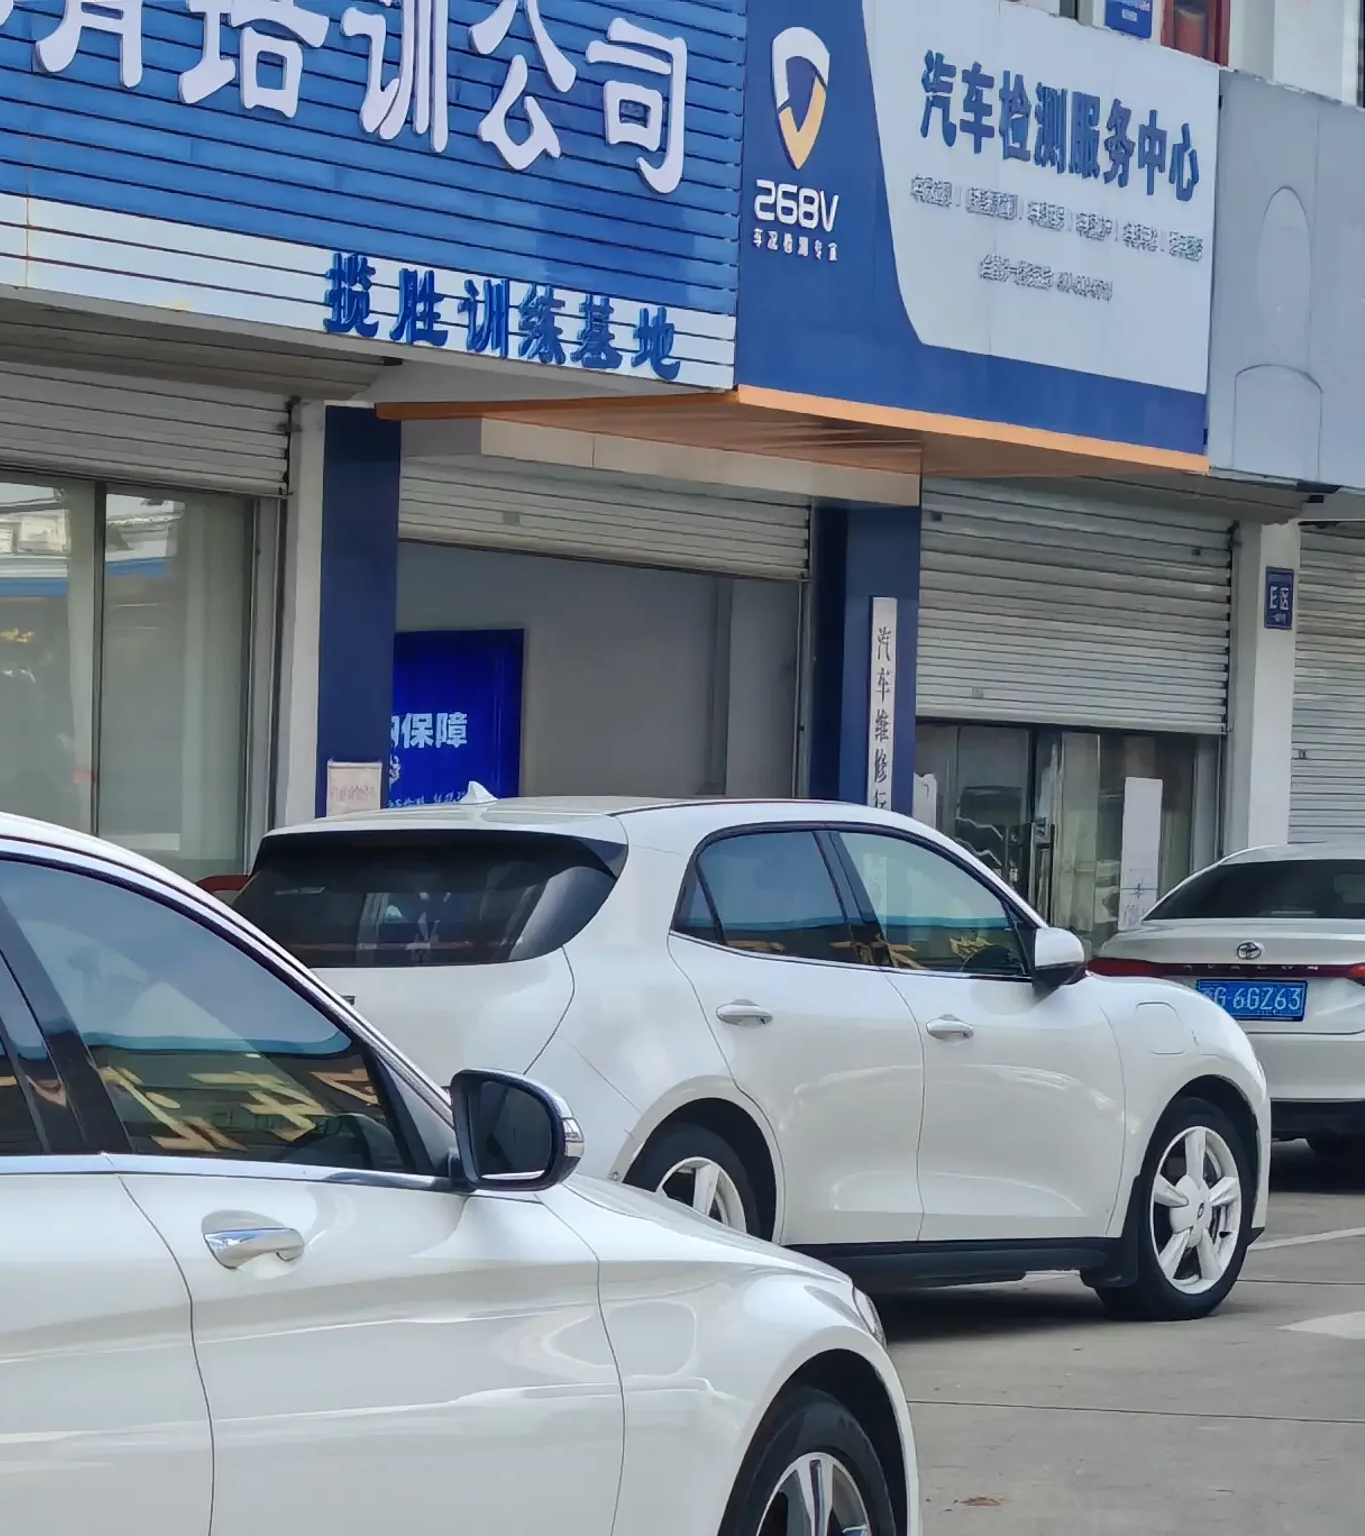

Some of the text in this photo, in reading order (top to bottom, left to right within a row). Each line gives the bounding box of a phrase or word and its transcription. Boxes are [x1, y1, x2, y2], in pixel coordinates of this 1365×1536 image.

[920, 49, 1200, 202] 汽车检测服务中心
[754, 179, 839, 232] 268V
